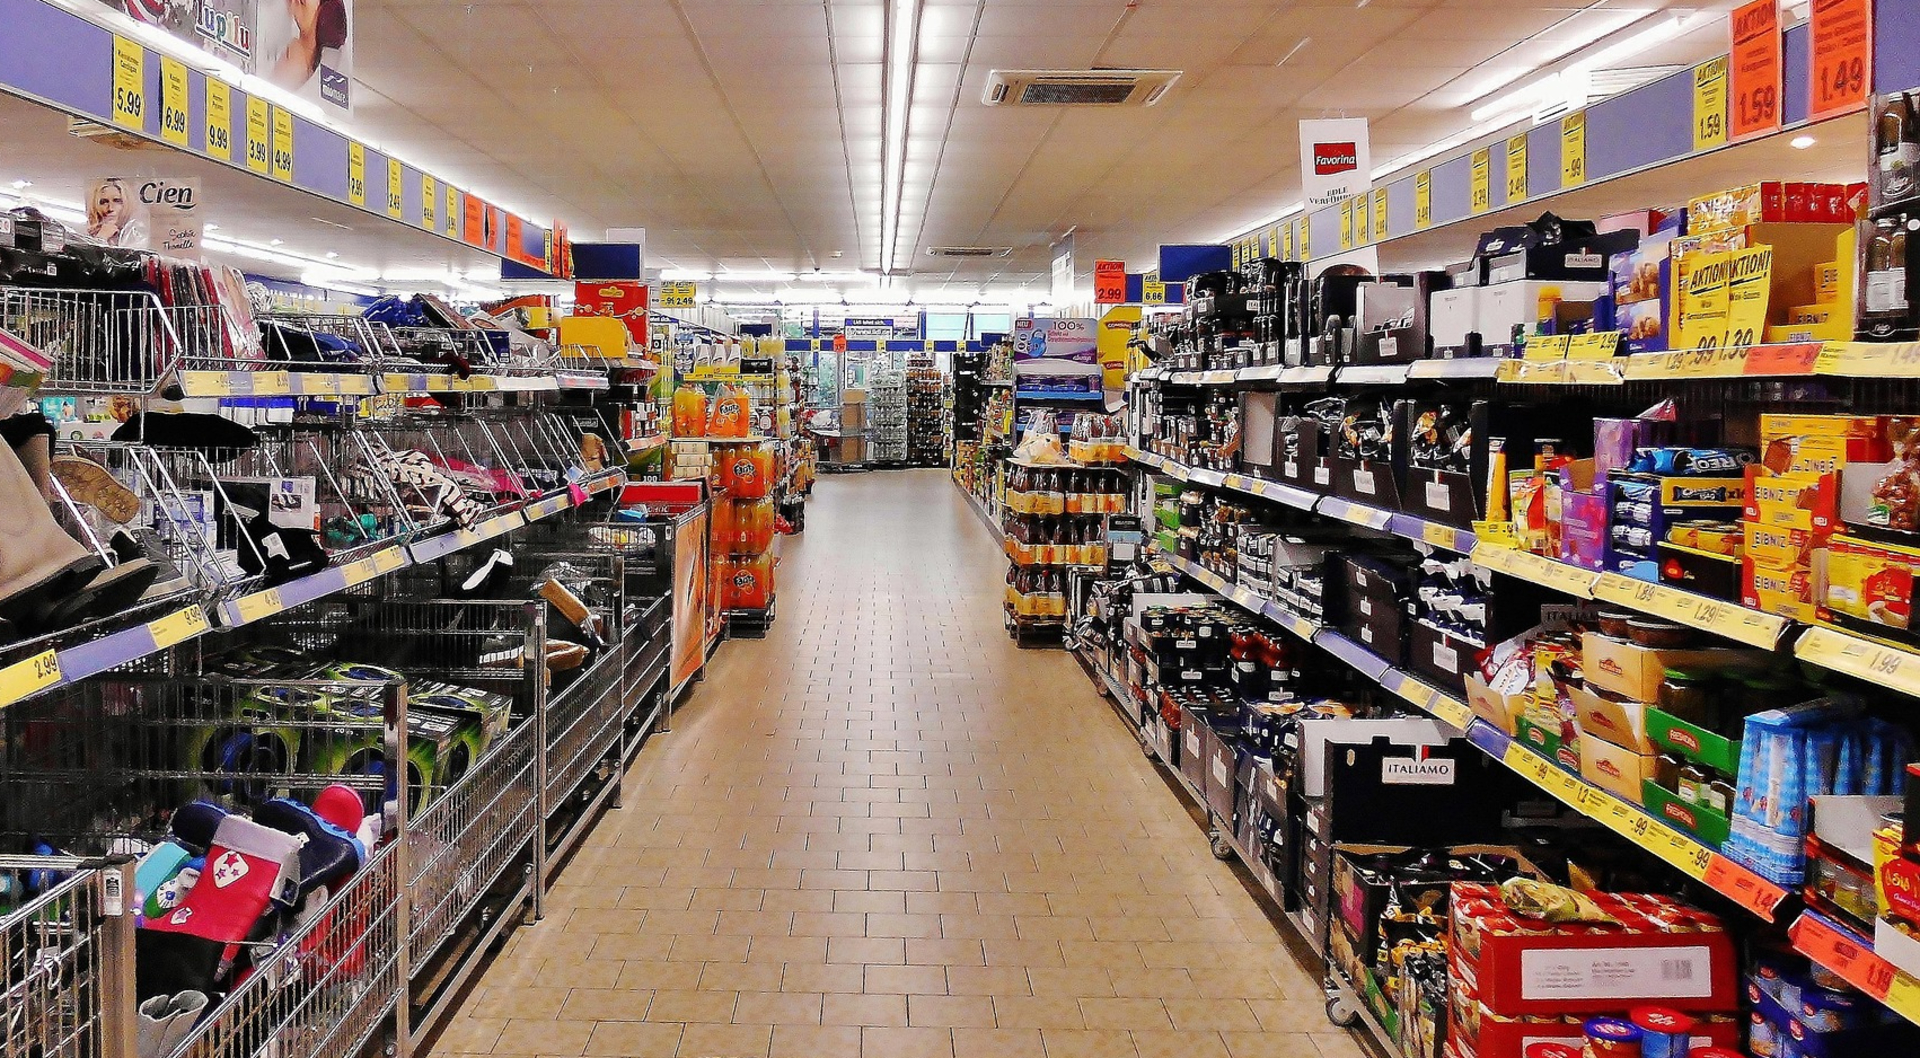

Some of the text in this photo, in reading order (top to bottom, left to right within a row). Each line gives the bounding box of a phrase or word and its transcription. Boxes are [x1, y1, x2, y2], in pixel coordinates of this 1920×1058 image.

[1821, 57, 1863, 101] 1.49
[116, 87, 141, 117] 5.99
[165, 106, 185, 134] 6.99
[1700, 113, 1720, 140] 1.59
[209, 125, 228, 149] 9.99
[249, 139, 266, 163] 3.99
[274, 149, 291, 171] 4.99
[1315, 155, 1356, 166] Favorina
[139, 182, 194, 205] Cien
[1097, 288, 1122, 300] 2.99
[1053, 321, 1085, 331] 100%
[720, 404, 740, 416] Fanta
[734, 464, 755, 478] Fanta
[733, 573, 755, 587] Fanta
[183, 606, 203, 626] 9.99
[34, 653, 57, 680] 2.99
[1868, 650, 1901, 675] 1.99
[1388, 764, 1449, 775] ITALIAMO
[1629, 816, 1648, 837] -.99
[1689, 847, 1711, 870] -.99
